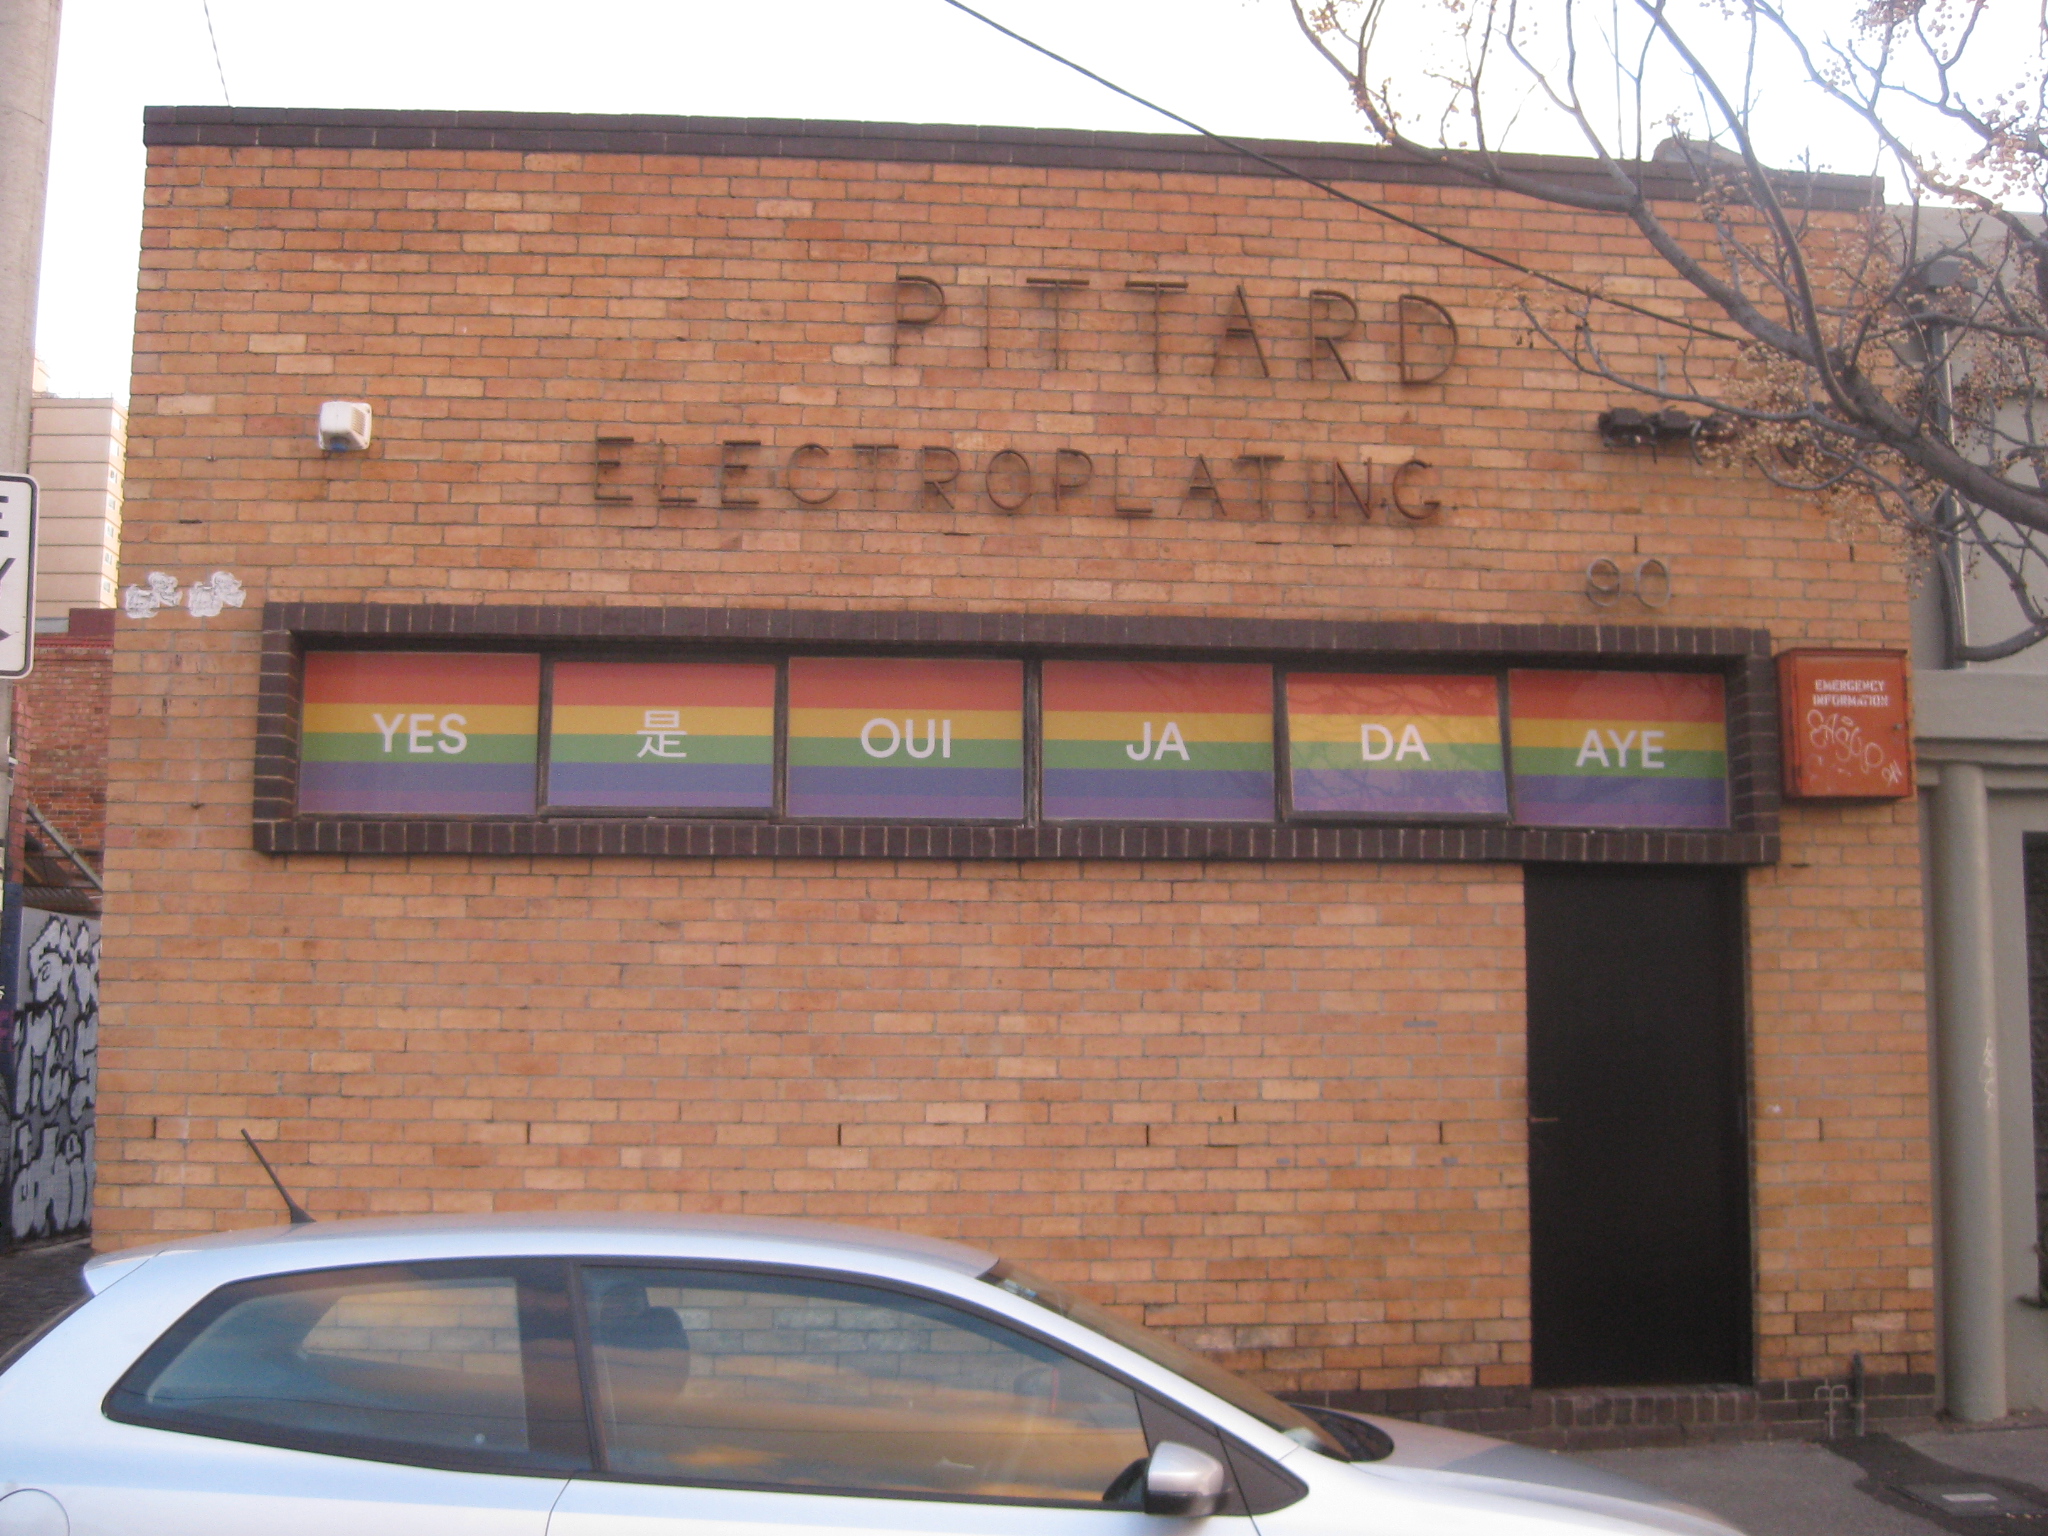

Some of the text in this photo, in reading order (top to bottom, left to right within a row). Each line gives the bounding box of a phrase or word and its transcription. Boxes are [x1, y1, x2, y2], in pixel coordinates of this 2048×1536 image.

[894, 273, 1460, 386] PITTARD
[594, 435, 1441, 521] ELECTROPLATING
[1586, 557, 1672, 608] 90
[1812, 694, 1890, 707] INFORMATION
[1814, 679, 1886, 692] EMERGENCY
[371, 713, 468, 754] YES
[636, 710, 689, 759] 是
[860, 717, 952, 759] OUI
[1126, 721, 1191, 761] JA
[1360, 723, 1431, 762] DA
[1575, 730, 1665, 769] AYE
